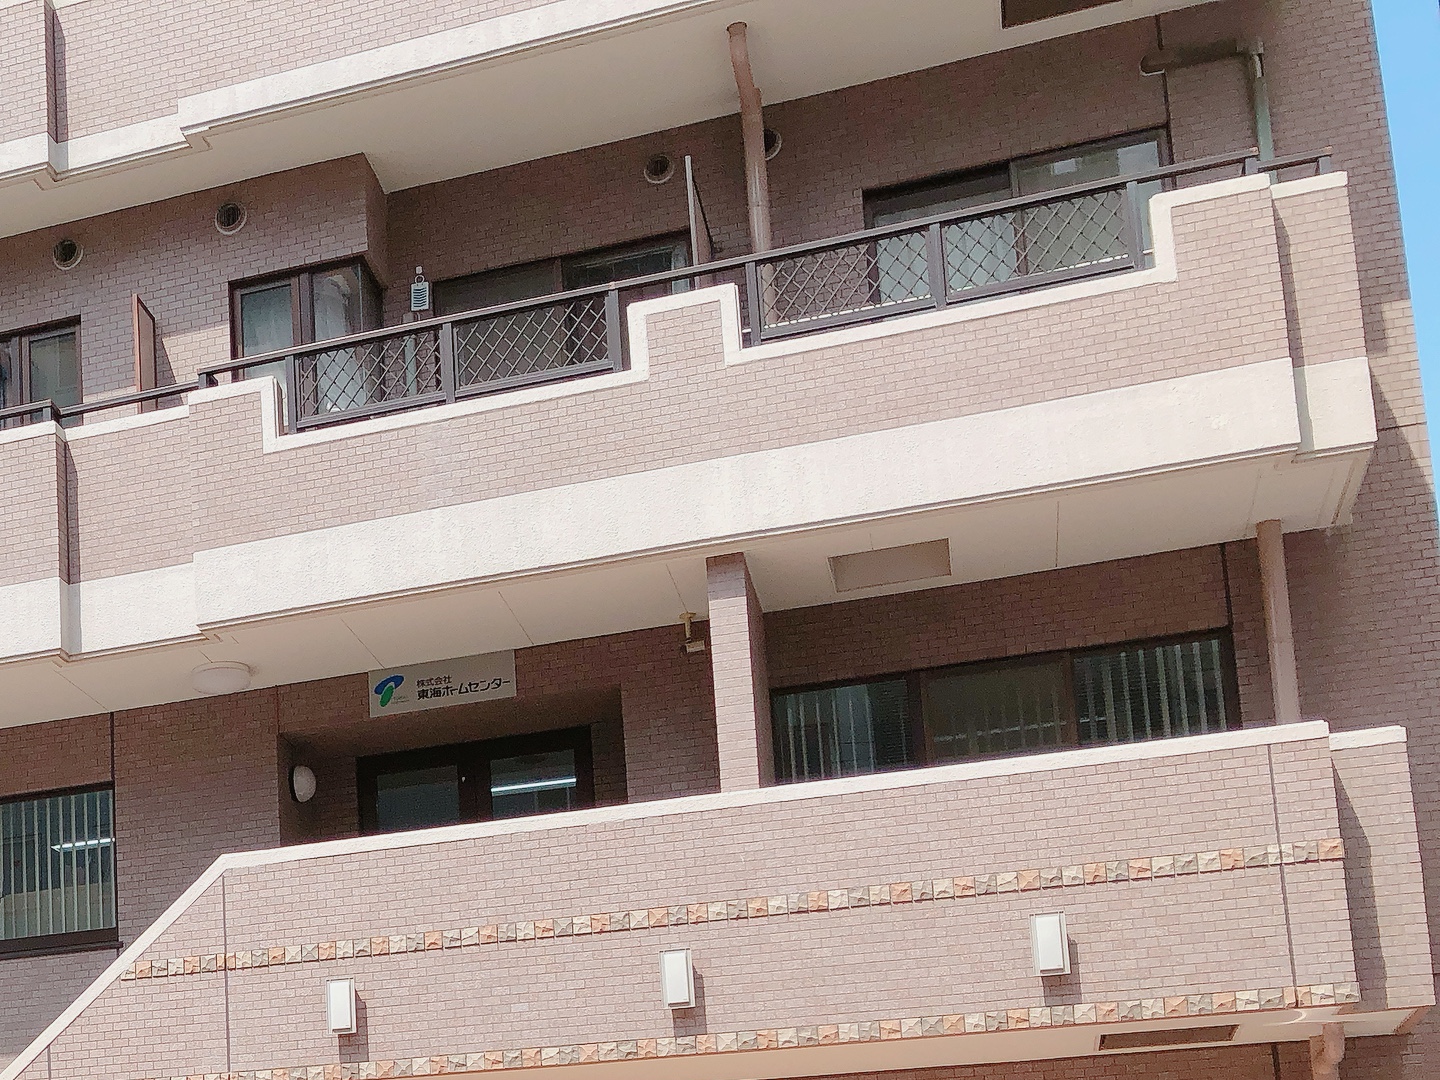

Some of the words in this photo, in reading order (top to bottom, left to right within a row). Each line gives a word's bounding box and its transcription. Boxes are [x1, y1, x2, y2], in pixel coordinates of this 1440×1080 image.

[416, 675, 452, 688] 株式会社
[417, 677, 511, 701] 東海ホームセンター
